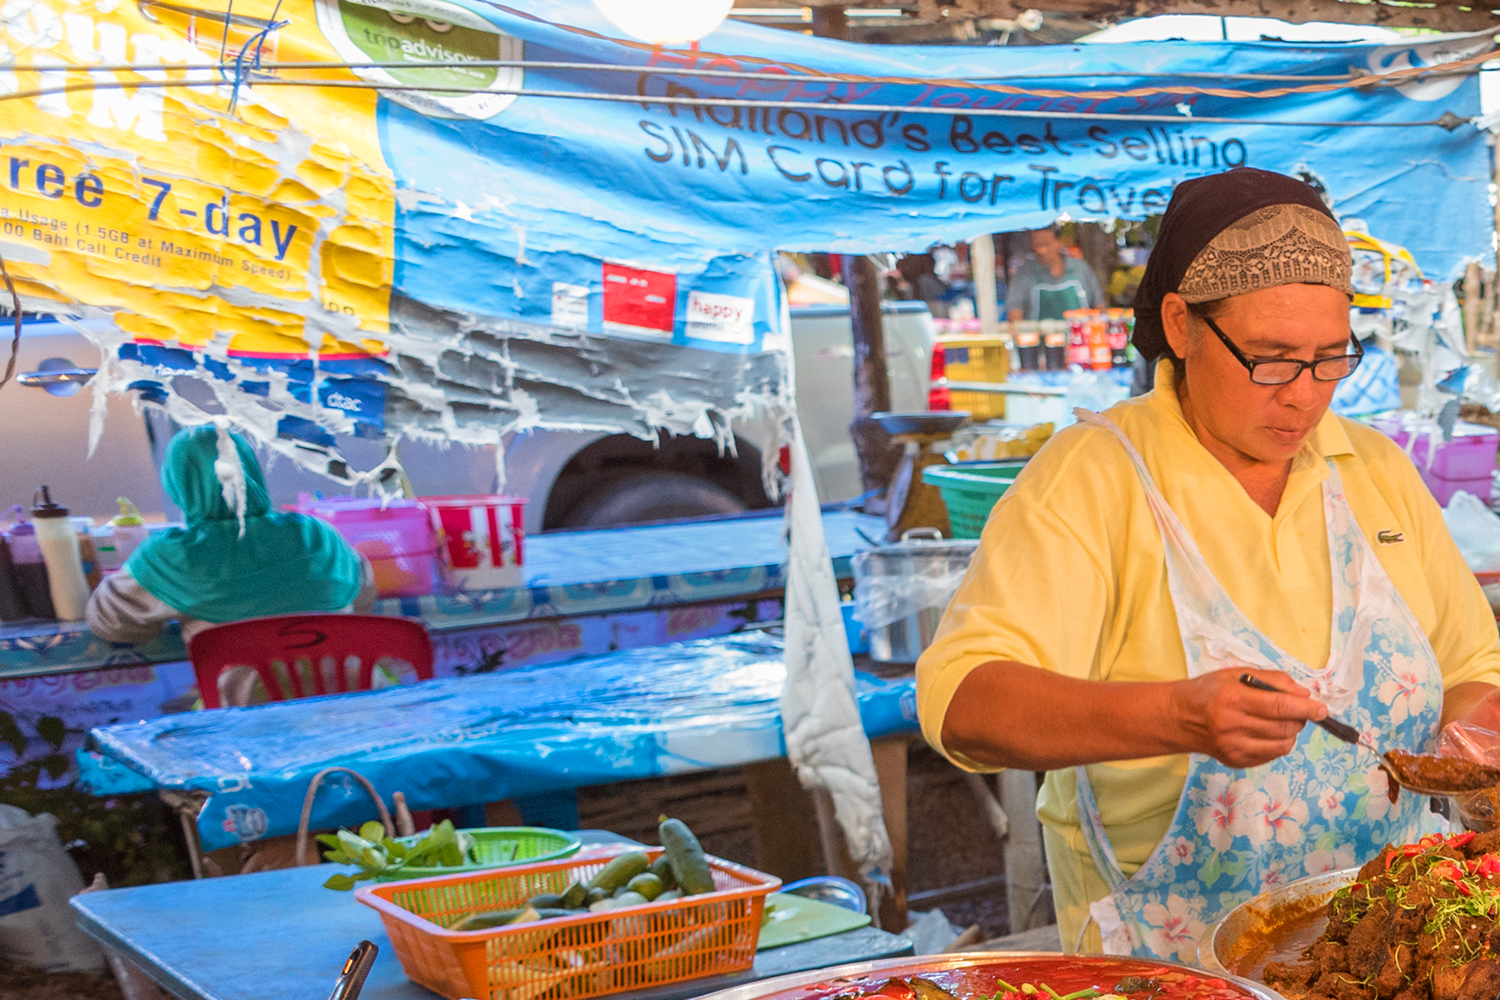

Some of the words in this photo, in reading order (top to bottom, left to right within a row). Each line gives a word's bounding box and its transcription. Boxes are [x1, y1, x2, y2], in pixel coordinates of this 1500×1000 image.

[638, 119, 749, 175] SIM
[766, 144, 915, 195] Card
[934, 160, 1017, 205] for
[1028, 163, 1178, 214] Trave
[9, 156, 104, 208] ree
[141, 176, 298, 261] 7-day
[19, 208, 67, 231] Usage
[76, 221, 130, 244] (1.5GB
[138, 237, 153, 250] at
[160, 240, 234, 267] Maximum
[242, 259, 291, 281] Speed)
[33, 228, 69, 244] Baht
[76, 239, 107, 255] Call
[115, 247, 162, 268] Credit
[691, 295, 744, 321] happy
